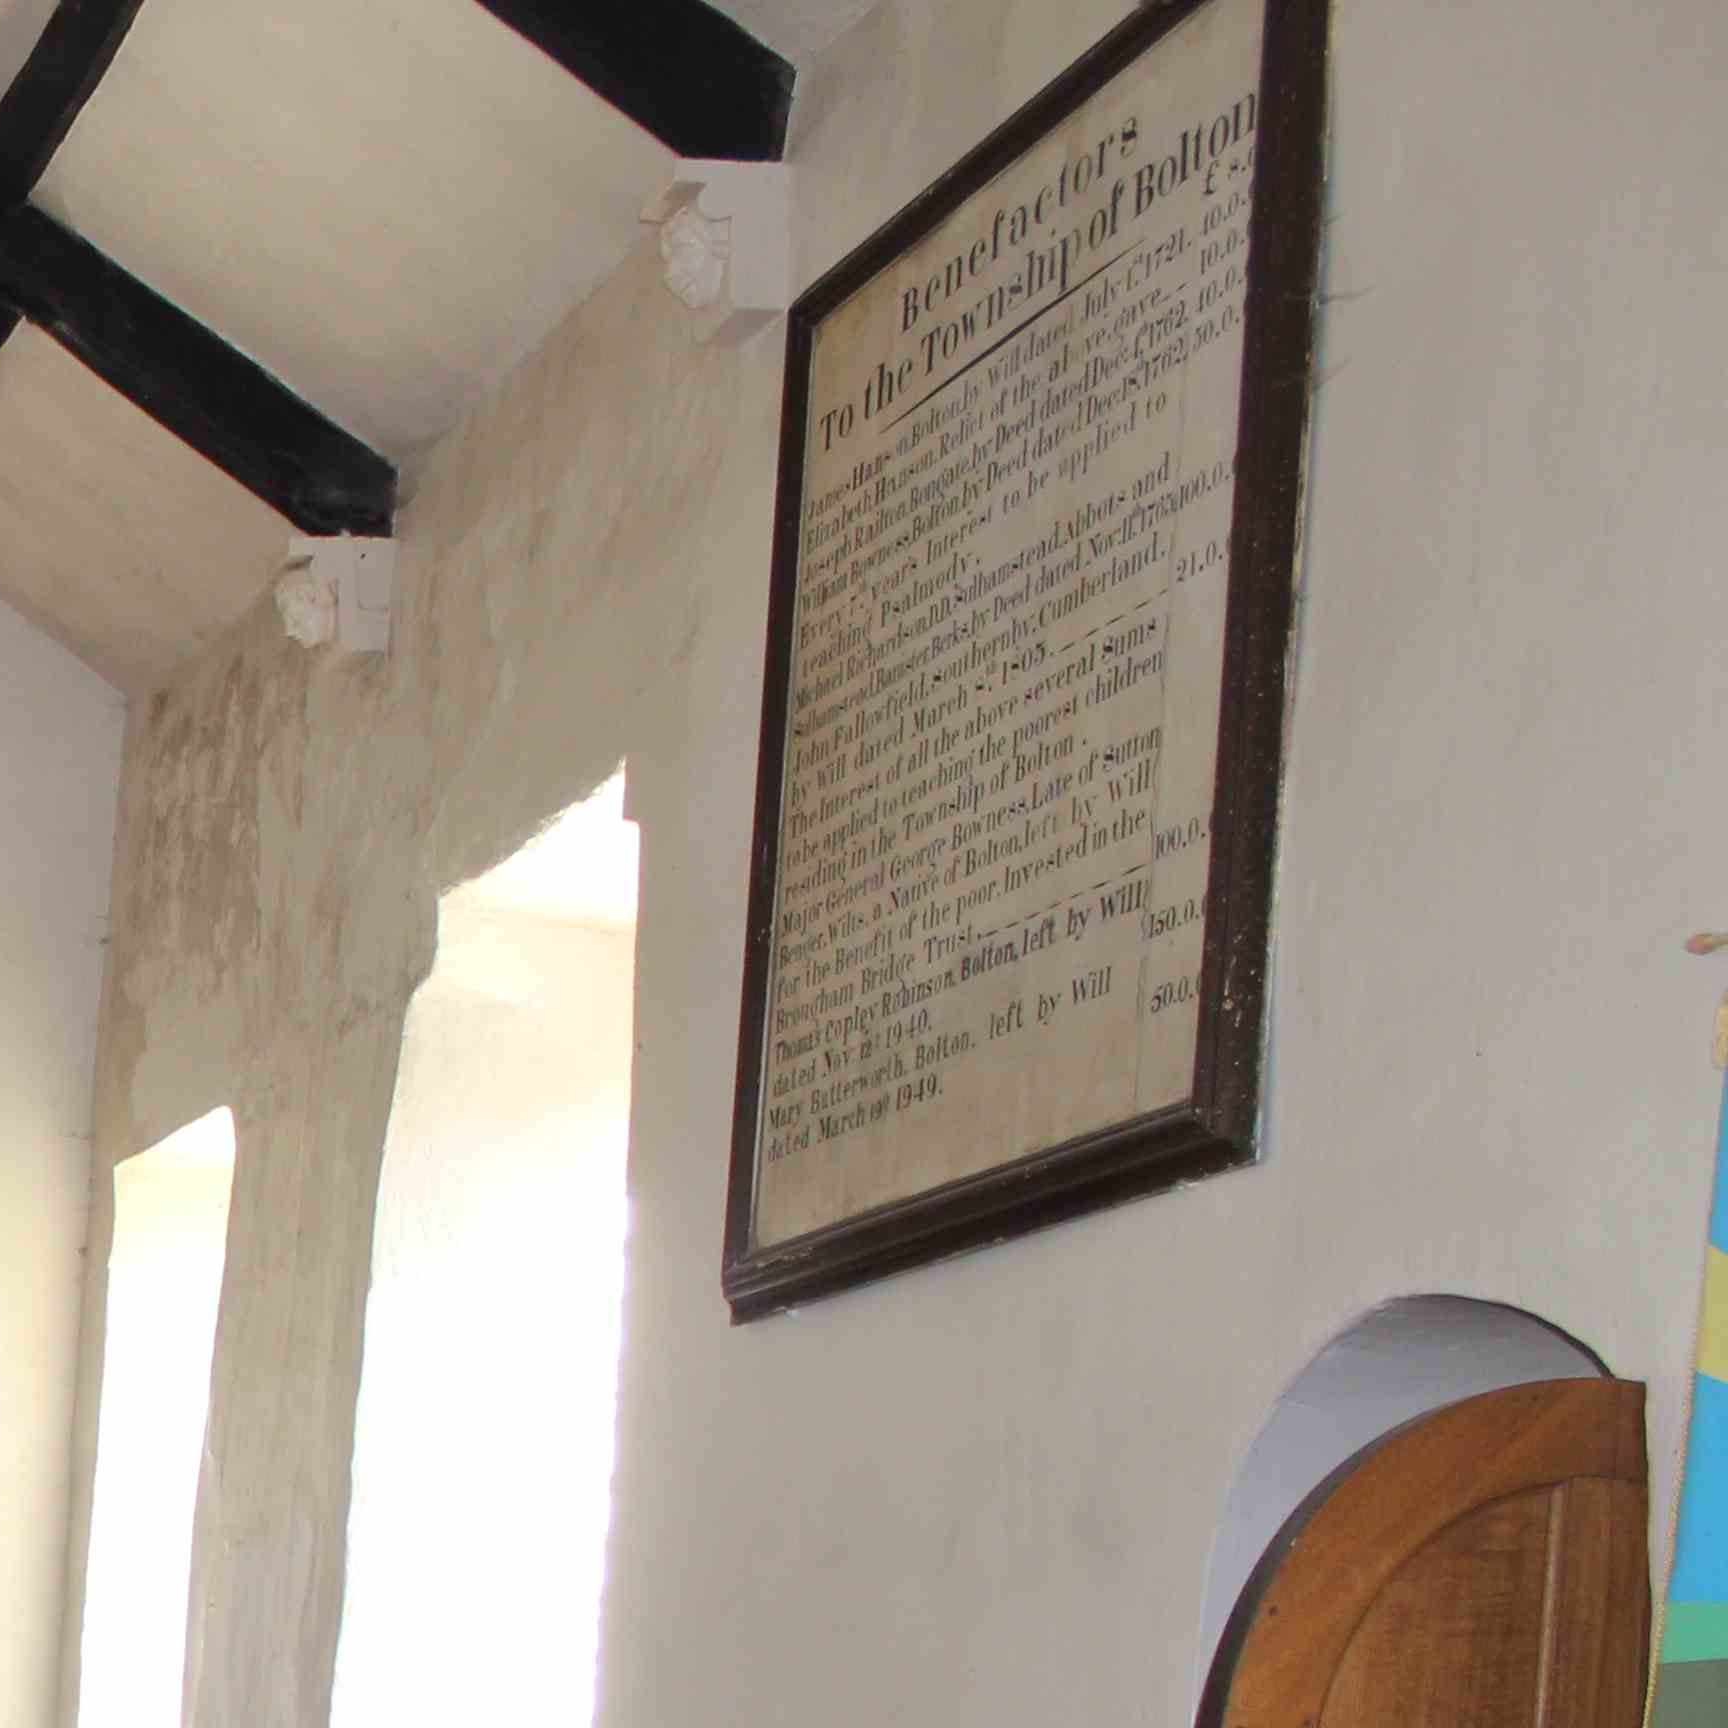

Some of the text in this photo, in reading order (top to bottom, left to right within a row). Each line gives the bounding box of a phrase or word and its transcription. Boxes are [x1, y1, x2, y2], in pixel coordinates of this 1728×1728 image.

[819, 403, 854, 452] To
[863, 359, 913, 420] the
[919, 228, 1081, 375] Township
[1087, 178, 1125, 250] of
[1134, 92, 1256, 217] Bolton
[901, 117, 1137, 332] Benefactors
[986, 342, 1021, 390] Will
[1022, 303, 1074, 365] dated
[1079, 276, 1122, 323] July
[994, 398, 1036, 454] Deed
[1038, 360, 1091, 423] dated
[1011, 372, 1041, 407] the
[925, 504, 992, 566] Interest
[1001, 488, 1021, 515] to
[1026, 468, 1050, 500] be
[1144, 390, 1167, 420] to
[985, 437, 1028, 492] Deed
[1032, 399, 1083, 461] dated
[1131, 449, 1170, 501] and
[992, 572, 1031, 623] Deed
[1033, 540, 1082, 596] dated
[791, 738, 830, 776] John
[1037, 530, 1165, 628] Cumberland.
[787, 808, 818, 840] The
[818, 771, 880, 824] Interest
[884, 752, 904, 785] of
[906, 736, 930, 774] all
[932, 725, 960, 759] the
[963, 695, 1019, 741] above
[1022, 642, 1096, 705] several
[815, 751, 847, 791] Will
[852, 714, 905, 771] dated
[910, 683, 968, 738] March
[978, 731, 1007, 766] the
[1011, 694, 1078, 760] poorest
[1076, 750, 1100, 785] of
[849, 839, 868, 870] in
[869, 825, 897, 859] the
[901, 773, 985, 841] Township
[988, 758, 1011, 795] of
[942, 853, 962, 887] of
[1107, 756, 1151, 803] Will
[804, 958, 831, 988] the
[833, 923, 893, 975] Benefit
[897, 908, 918, 941] of
[921, 899, 951, 931] the
[1003, 822, 1088, 894] Invested
[1091, 820, 1108, 852] in
[1111, 807, 1146, 842] the
[1065, 906, 1092, 942] by
[1099, 878, 1142, 920] Will
[859, 951, 916, 995] Bridge
[768, 1100, 804, 1130] Mary
[988, 999, 1023, 1040] left
[1035, 991, 1062, 1026] by
[1071, 964, 1112, 1005] Will
[771, 1056, 817, 1098] dated
[766, 1123, 811, 1163] dated
[816, 1101, 866, 1144] March
